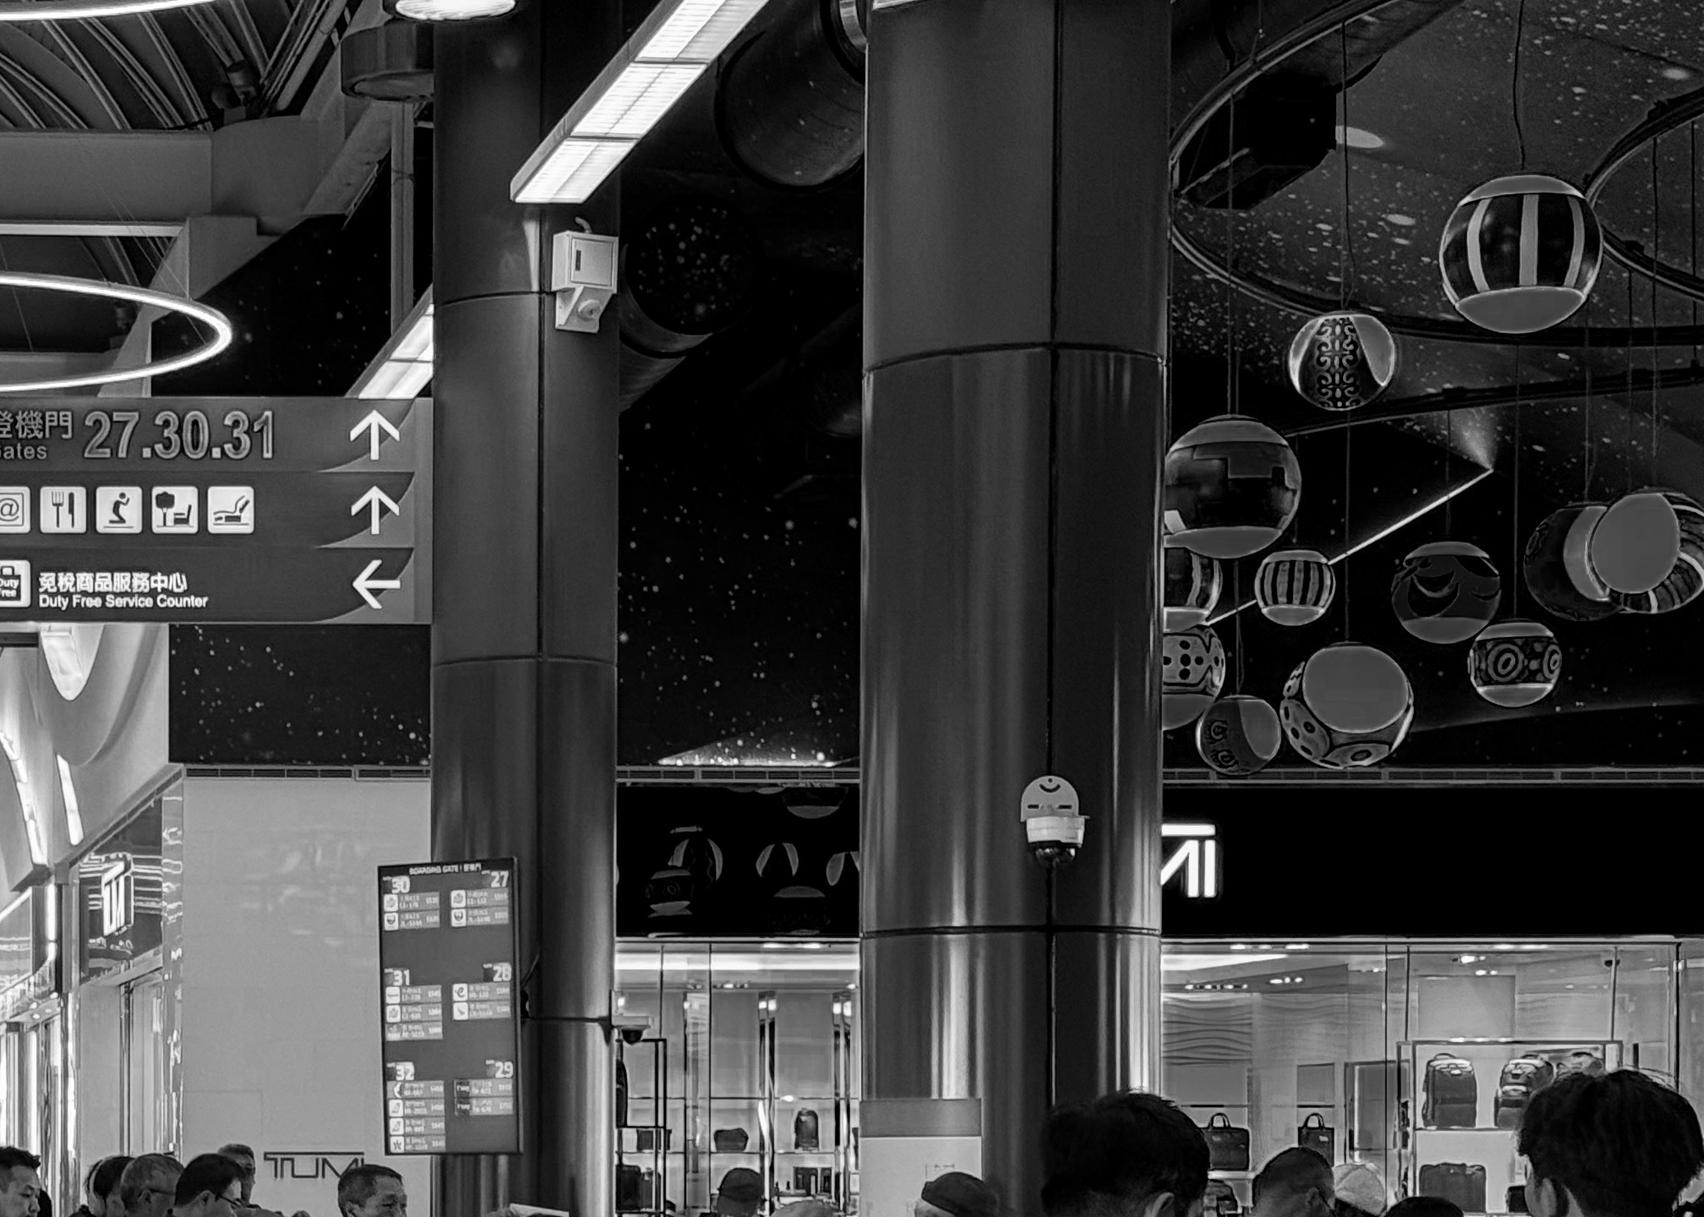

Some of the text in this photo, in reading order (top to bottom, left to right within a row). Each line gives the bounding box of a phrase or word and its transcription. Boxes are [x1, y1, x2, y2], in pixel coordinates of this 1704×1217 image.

[84, 410, 273, 460] 27.30.31
[39, 572, 188, 593] 免稅商品服務中心
[39, 594, 208, 611] Duty Free Service Counter
[392, 876, 410, 893] 30
[491, 870, 509, 888] 27
[393, 969, 410, 986] 31
[396, 1062, 415, 1081] 32
[495, 1061, 514, 1079] 29
[264, 1152, 364, 1179] TUM
